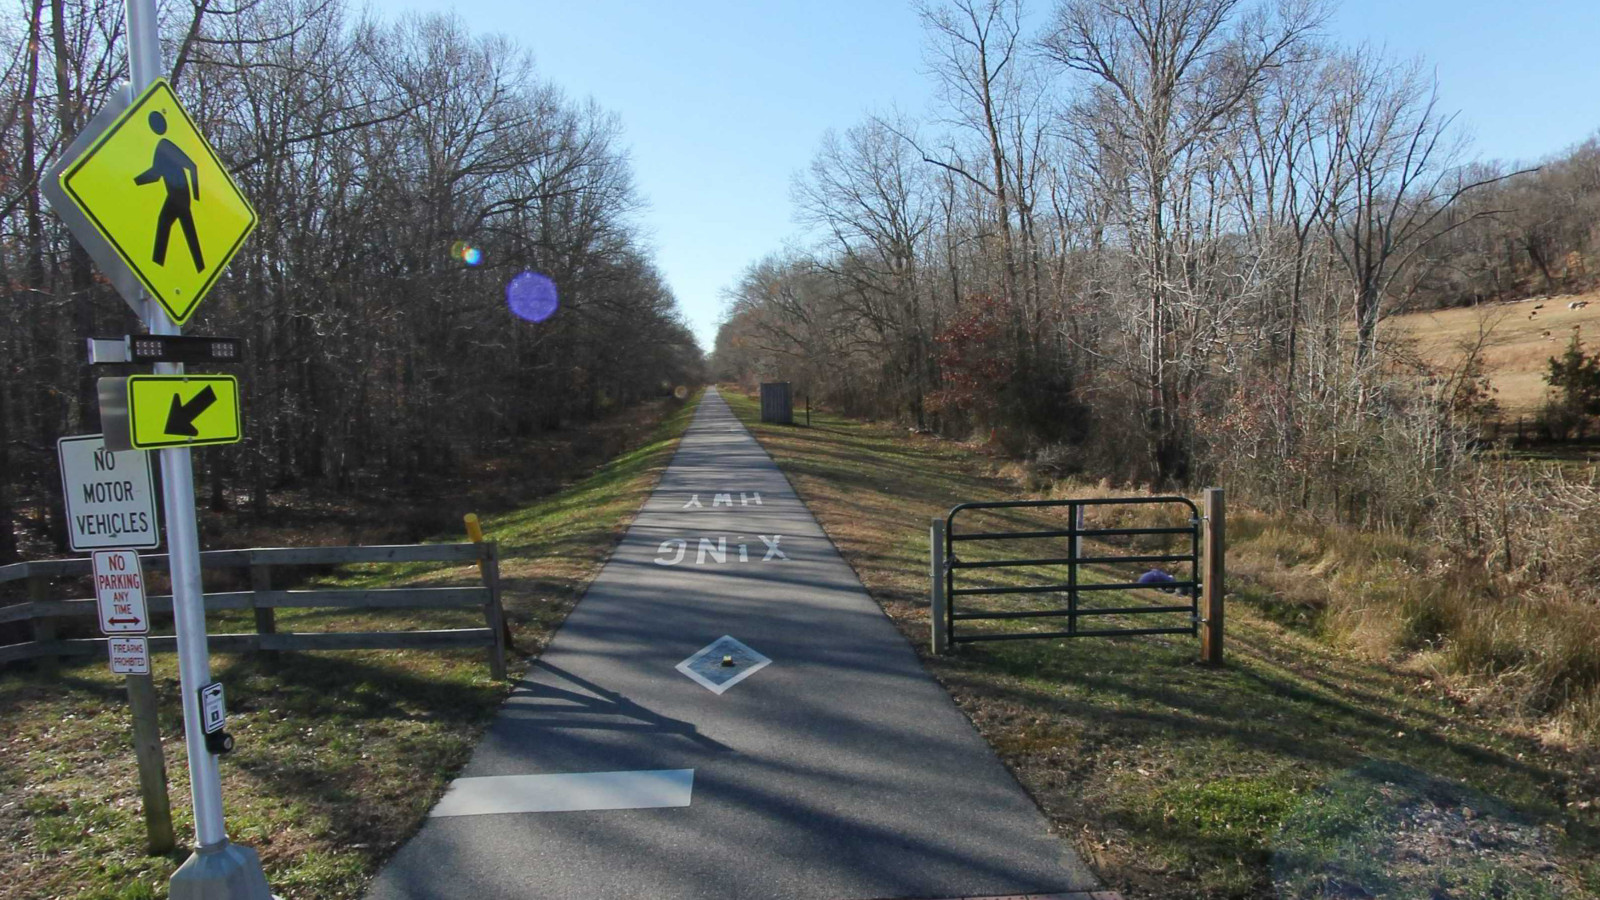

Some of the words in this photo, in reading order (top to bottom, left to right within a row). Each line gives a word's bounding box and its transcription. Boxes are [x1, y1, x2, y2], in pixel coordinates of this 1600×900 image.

[94, 450, 116, 471] NO
[83, 481, 134, 503] MOTOR
[76, 512, 148, 535] VEHICLES
[108, 555, 126, 571] NO
[100, 574, 140, 590] PARKING
[113, 592, 129, 603] ANY
[113, 604, 132, 616] TIME
[113, 644, 144, 654] FIREARMS
